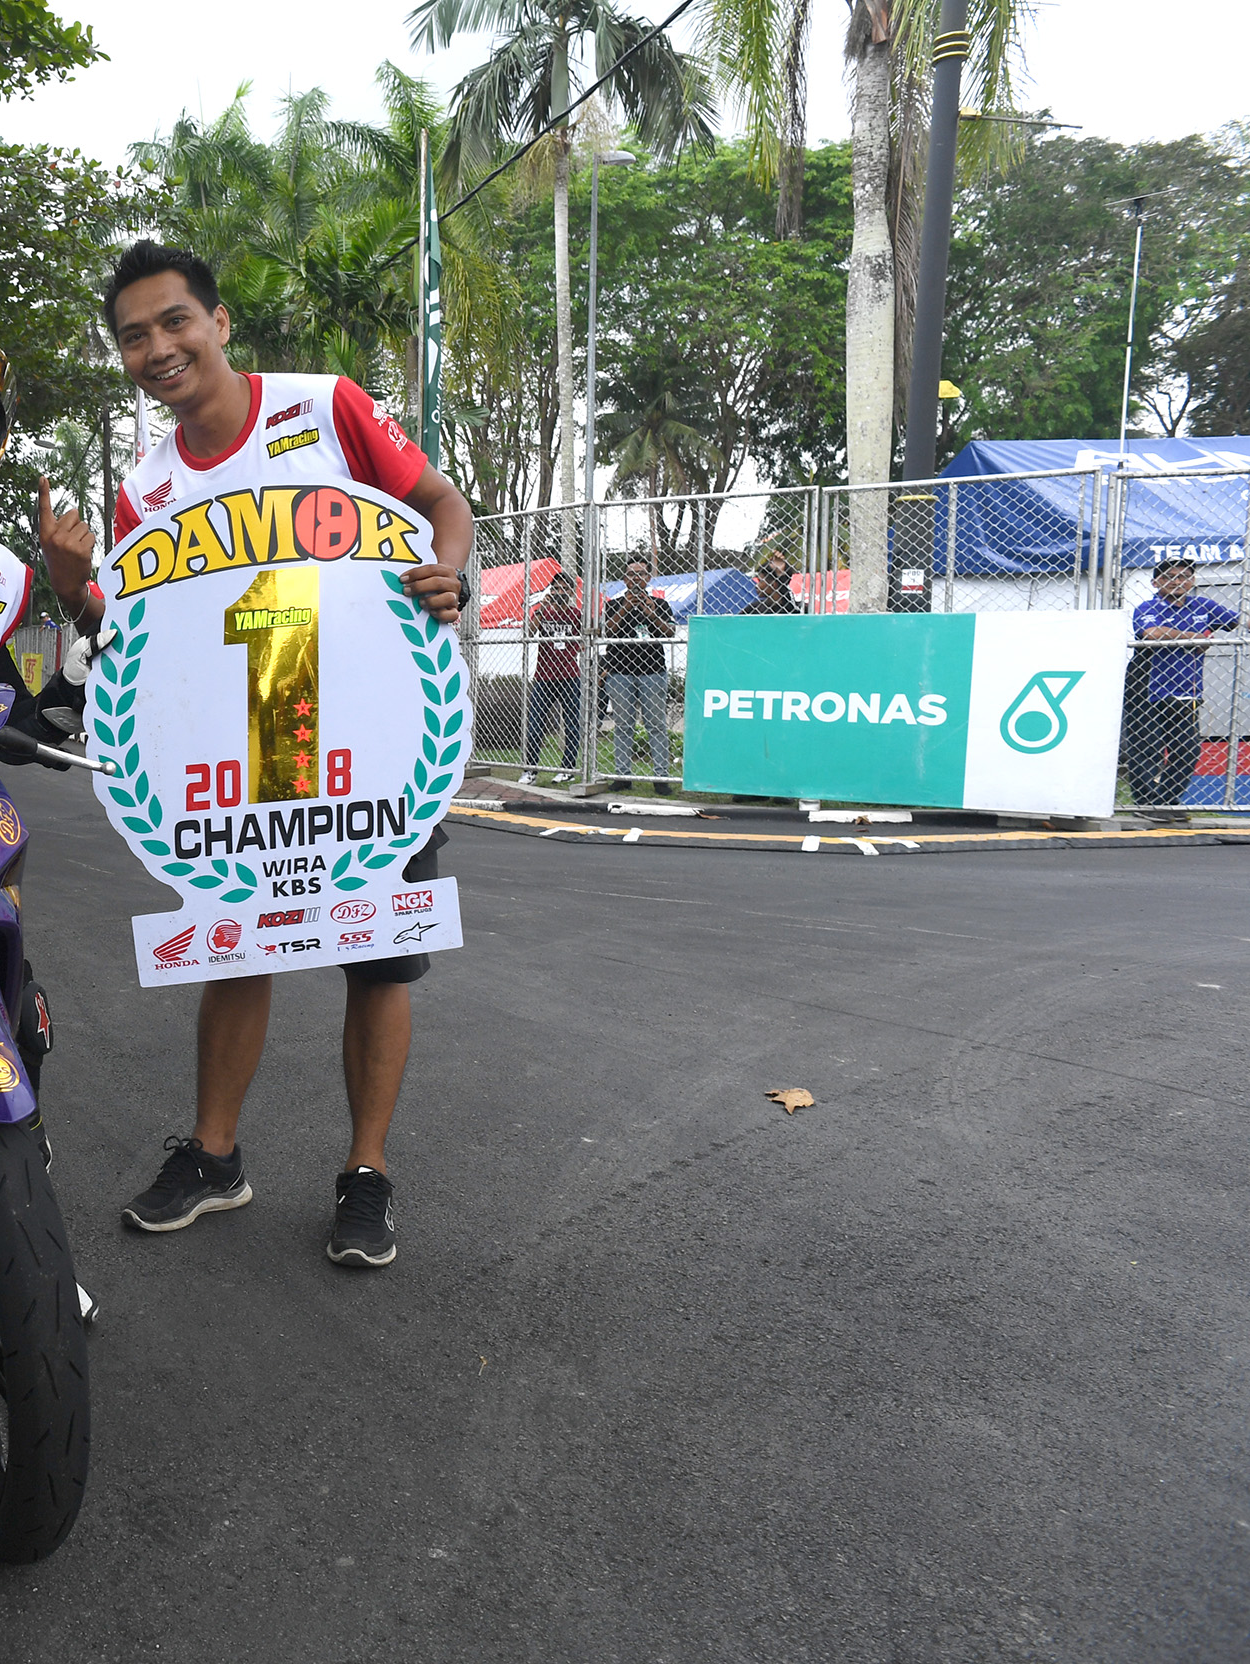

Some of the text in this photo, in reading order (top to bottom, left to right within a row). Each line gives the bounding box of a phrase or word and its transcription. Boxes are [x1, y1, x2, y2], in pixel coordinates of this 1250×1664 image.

[266, 428, 320, 459] YAMracing
[1150, 544, 1222, 563] TEAM
[234, 607, 312, 631] YAMracing
[703, 688, 948, 727] PETRONAS
[174, 796, 407, 860] CHAMPION
[262, 855, 327, 878] WIRA
[272, 876, 323, 898] KBS
[393, 891, 433, 911] NGK
[278, 938, 322, 954] TSR
[338, 931, 373, 944] SSS
[155, 958, 200, 971] HONDA
[208, 952, 246, 964] IDEMITSU
